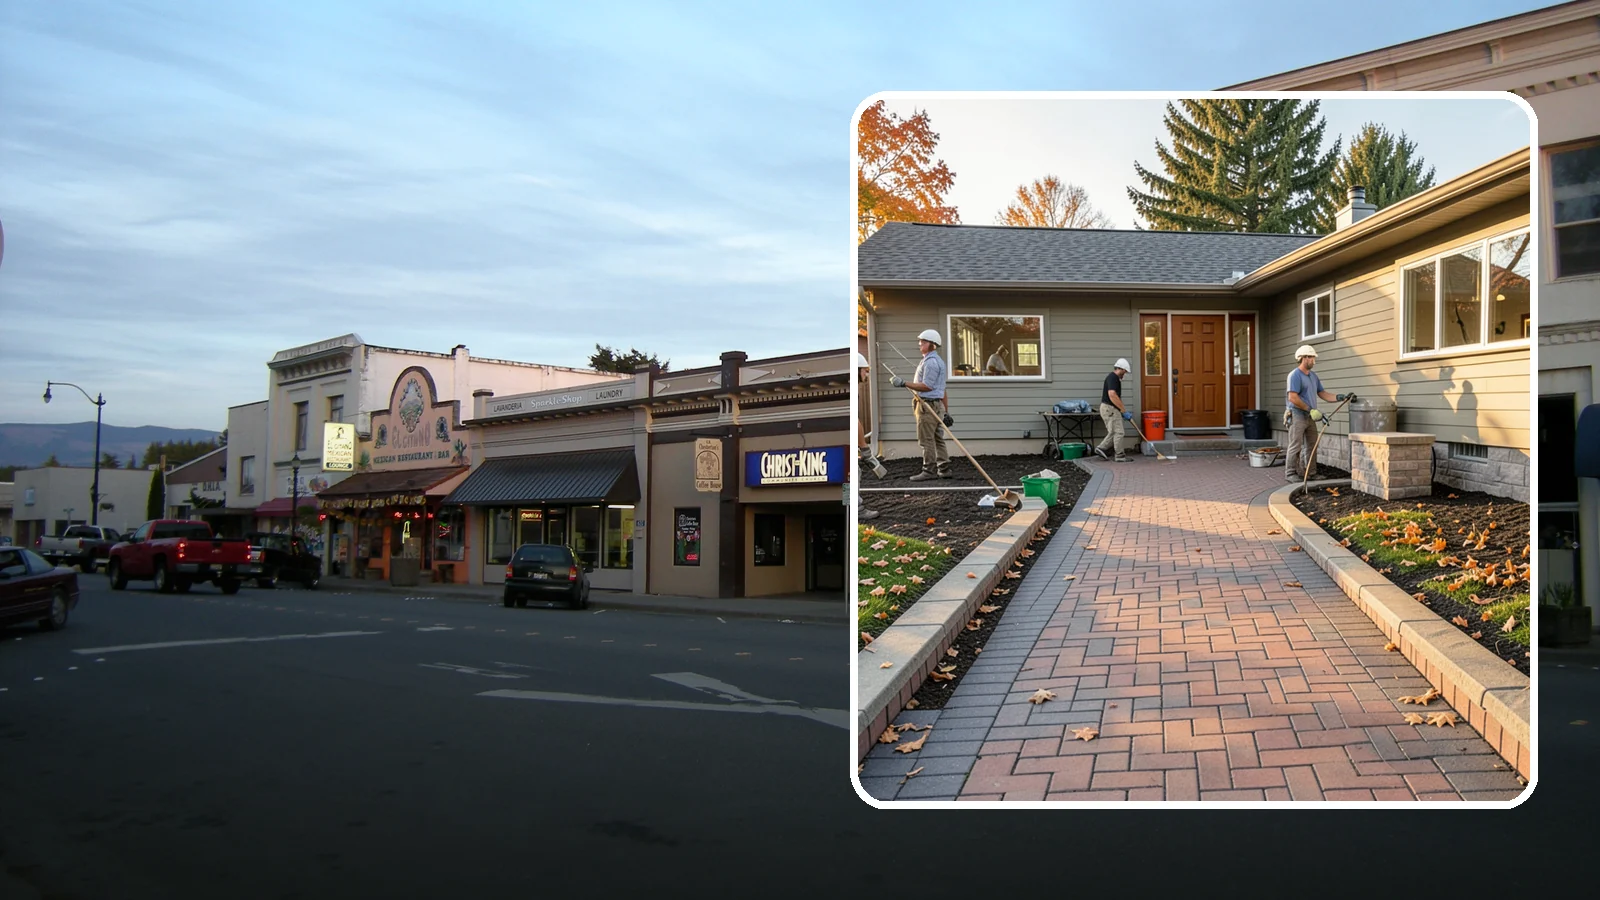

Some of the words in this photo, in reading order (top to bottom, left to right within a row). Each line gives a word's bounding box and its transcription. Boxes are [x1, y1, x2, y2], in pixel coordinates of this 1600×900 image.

[595, 389, 623, 399] LAUNDRY
[493, 402, 522, 413] LAVANDERIA
[530, 396, 560, 409] Sparkle
[561, 394, 582, 406] Shop
[374, 454, 396, 464] MEXICAN
[397, 451, 433, 462] RESTAURANT
[438, 450, 450, 459] BAR
